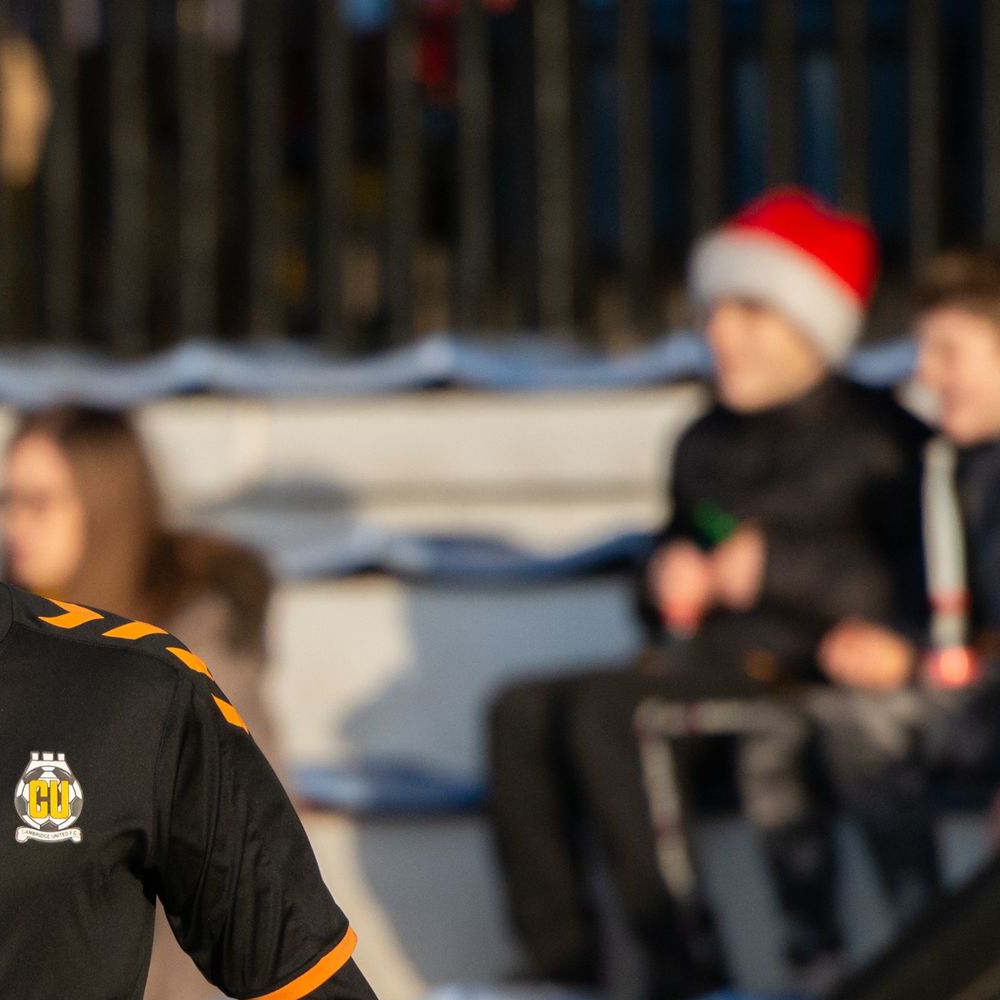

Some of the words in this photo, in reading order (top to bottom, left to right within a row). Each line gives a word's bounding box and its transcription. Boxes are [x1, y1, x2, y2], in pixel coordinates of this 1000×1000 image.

[29, 780, 69, 819] CU
[21, 829, 50, 839] CAMBRIDGE
[51, 830, 69, 839] UNITED
